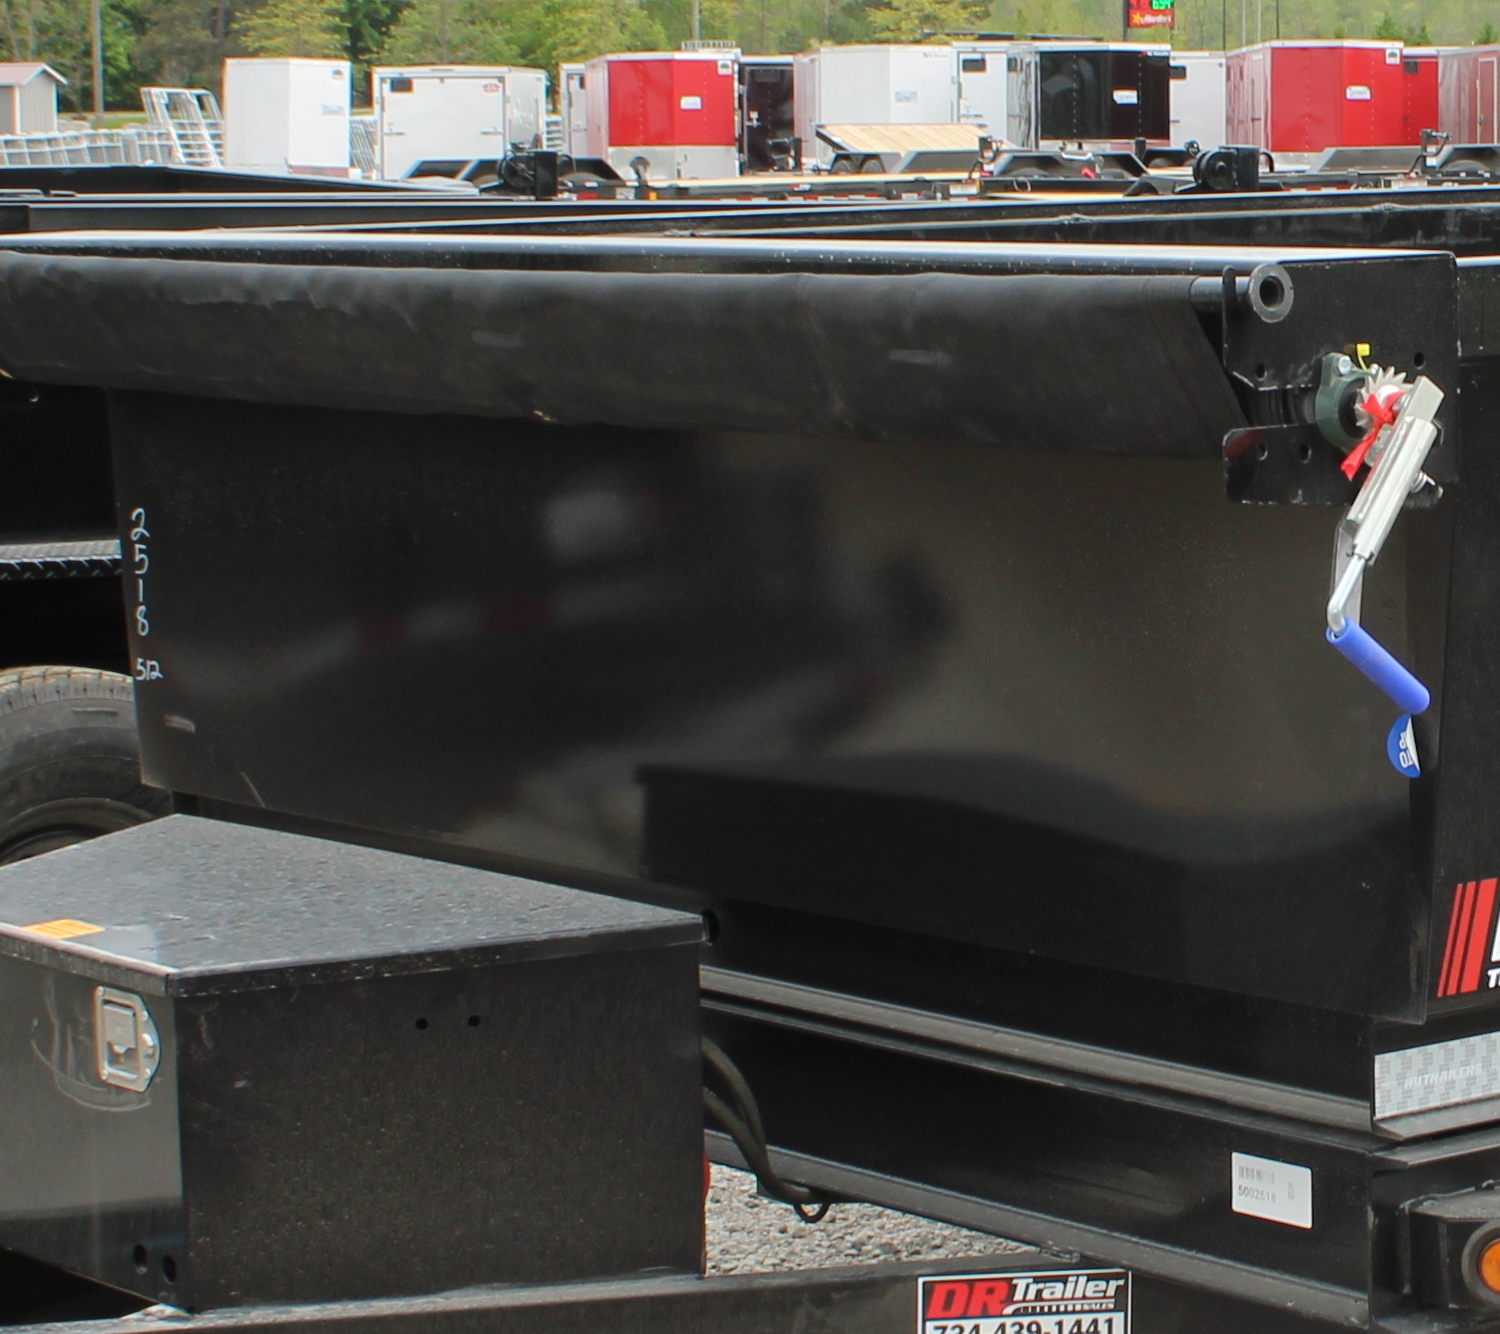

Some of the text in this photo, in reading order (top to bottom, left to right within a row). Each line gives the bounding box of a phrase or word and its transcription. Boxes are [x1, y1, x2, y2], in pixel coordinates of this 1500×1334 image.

[1238, 1184, 1276, 1205] 5002518
[927, 1275, 1125, 1319] DR Trailer
